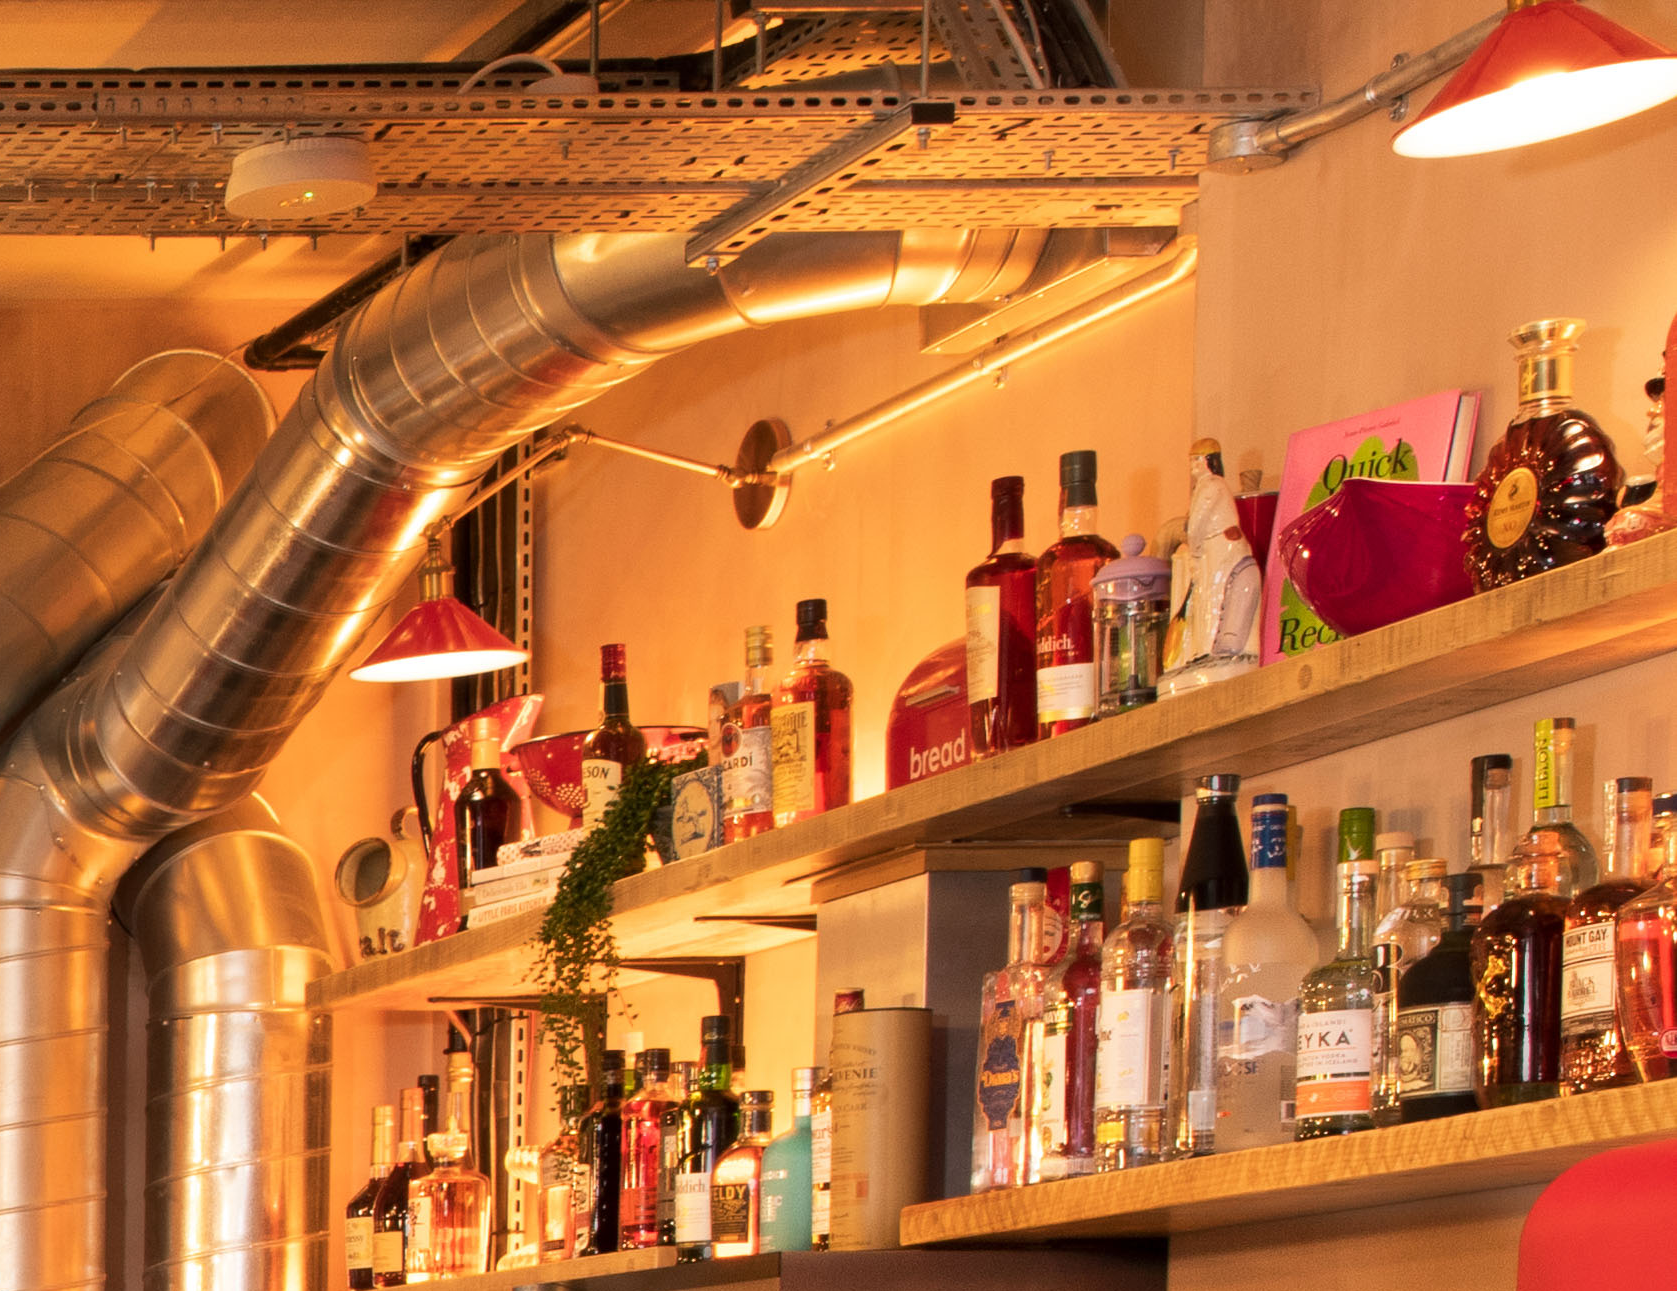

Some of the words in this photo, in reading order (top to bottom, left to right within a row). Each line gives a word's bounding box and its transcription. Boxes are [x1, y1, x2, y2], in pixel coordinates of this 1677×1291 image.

[1323, 438, 1411, 493] Quick
[910, 728, 965, 781] bread
[1538, 737, 1549, 801] LEBLON
[1588, 928, 1608, 943] GAY
